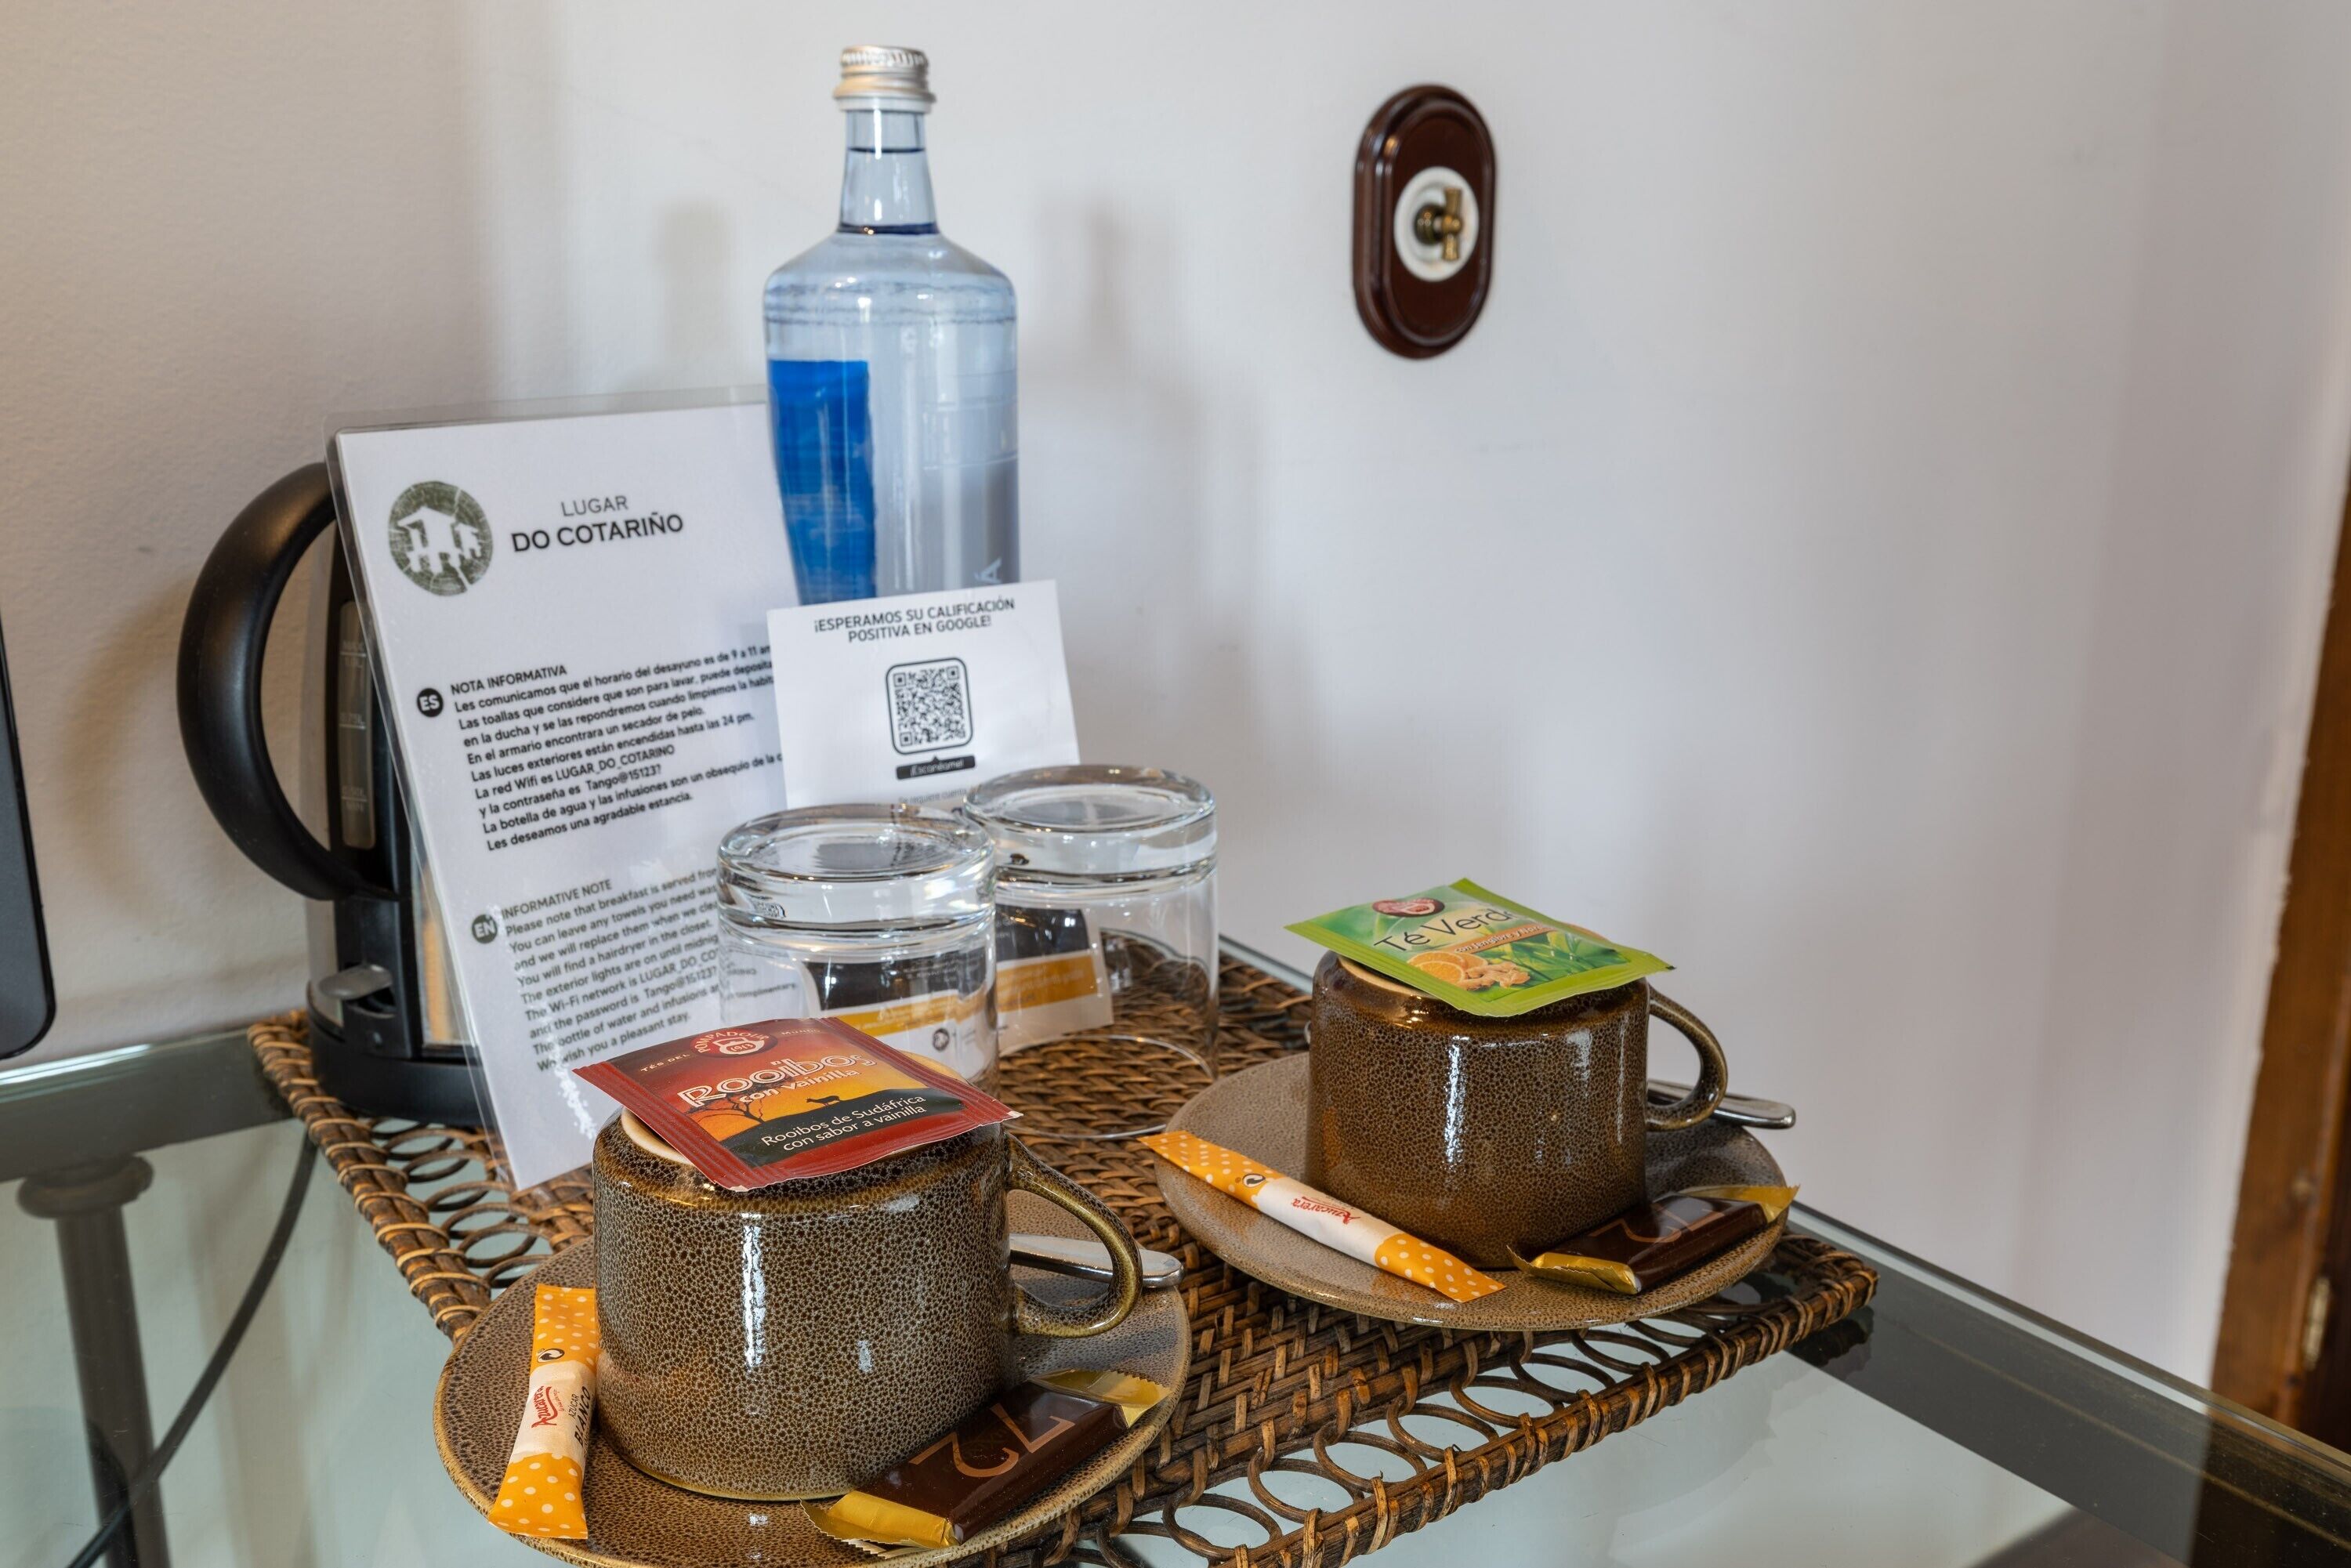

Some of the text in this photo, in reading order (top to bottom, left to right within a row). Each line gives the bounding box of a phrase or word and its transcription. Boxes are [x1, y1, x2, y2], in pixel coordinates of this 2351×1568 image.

[561, 495, 629, 517] LUGAR
[511, 512, 683, 552] DO COTARIÑO
[814, 596, 1015, 633] ¡ESPERAMOS SU CALIFICACIÓN
[849, 615, 992, 643] POSITIVA EN GOOGLE!
[450, 664, 567, 694] NOTA INFORMATIVA
[454, 701, 475, 712] Les
[478, 686, 556, 708] comunicamos
[559, 682, 579, 694] que
[594, 671, 632, 685] horario
[634, 666, 650, 678] del
[653, 658, 701, 674] desayuno
[458, 719, 479, 730] Las
[481, 710, 520, 725] toallas
[523, 706, 544, 719] que
[547, 695, 600, 712] considere
[603, 690, 622, 702] que
[625, 686, 644, 697] son
[646, 681, 669, 694] para
[733, 661, 771, 675] deposita
[419, 694, 440, 712] ES
[463, 737, 479, 747] en
[480, 733, 491, 743] la
[494, 726, 530, 741] ducha
[542, 721, 555, 730] se
[557, 717, 573, 727] las
[575, 702, 646, 723] repondremos
[648, 693, 686, 708] cuando
[748, 675, 773, 687] habit
[467, 753, 482, 764] En
[484, 748, 495, 760] el
[498, 741, 542, 758] armario
[545, 728, 603, 748] encontrara
[605, 725, 619, 734] un
[621, 715, 661, 731] secador
[665, 712, 678, 721] de
[471, 770, 491, 781] Las
[493, 762, 524, 777] luces
[527, 750, 582, 769] exteriores
[585, 742, 614, 756] están
[616, 730, 676, 749] encendidas
[475, 788, 489, 799] La
[492, 780, 512, 795] red
[514, 775, 538, 789] Wifi
[540, 774, 553, 784] es
[488, 803, 499, 813] la
[502, 788, 565, 810] contraseña
[568, 785, 580, 795] es
[483, 823, 497, 833] La
[499, 812, 539, 829] botella
[542, 808, 556, 819] de
[560, 802, 586, 815] agua
[597, 795, 613, 805] las
[615, 781, 668, 800] infusiones
[670, 777, 688, 788] son
[487, 792, 692, 850] Les deseamos una agradable estancia.
[501, 888, 579, 919] INFORMATIVE
[474, 920, 495, 938] EN
[1374, 932, 1431, 951] Té
[694, 1030, 770, 1053] POMPADOUR
[730, 1043, 754, 1052] 1913
[640, 1061, 665, 1072] TÉS
[739, 1068, 860, 1103] con vainilla
[761, 1096, 926, 1146] Rooibos de Sudáfrica
[784, 1105, 927, 1152] con sabor a vainilla
[1291, 1196, 1360, 1226] Azucarera
[531, 1385, 558, 1429] Azucarera
[568, 1393, 580, 1419] AZÚCAR
[574, 1386, 591, 1448] BLANCO
[908, 1403, 1075, 1478] 72
